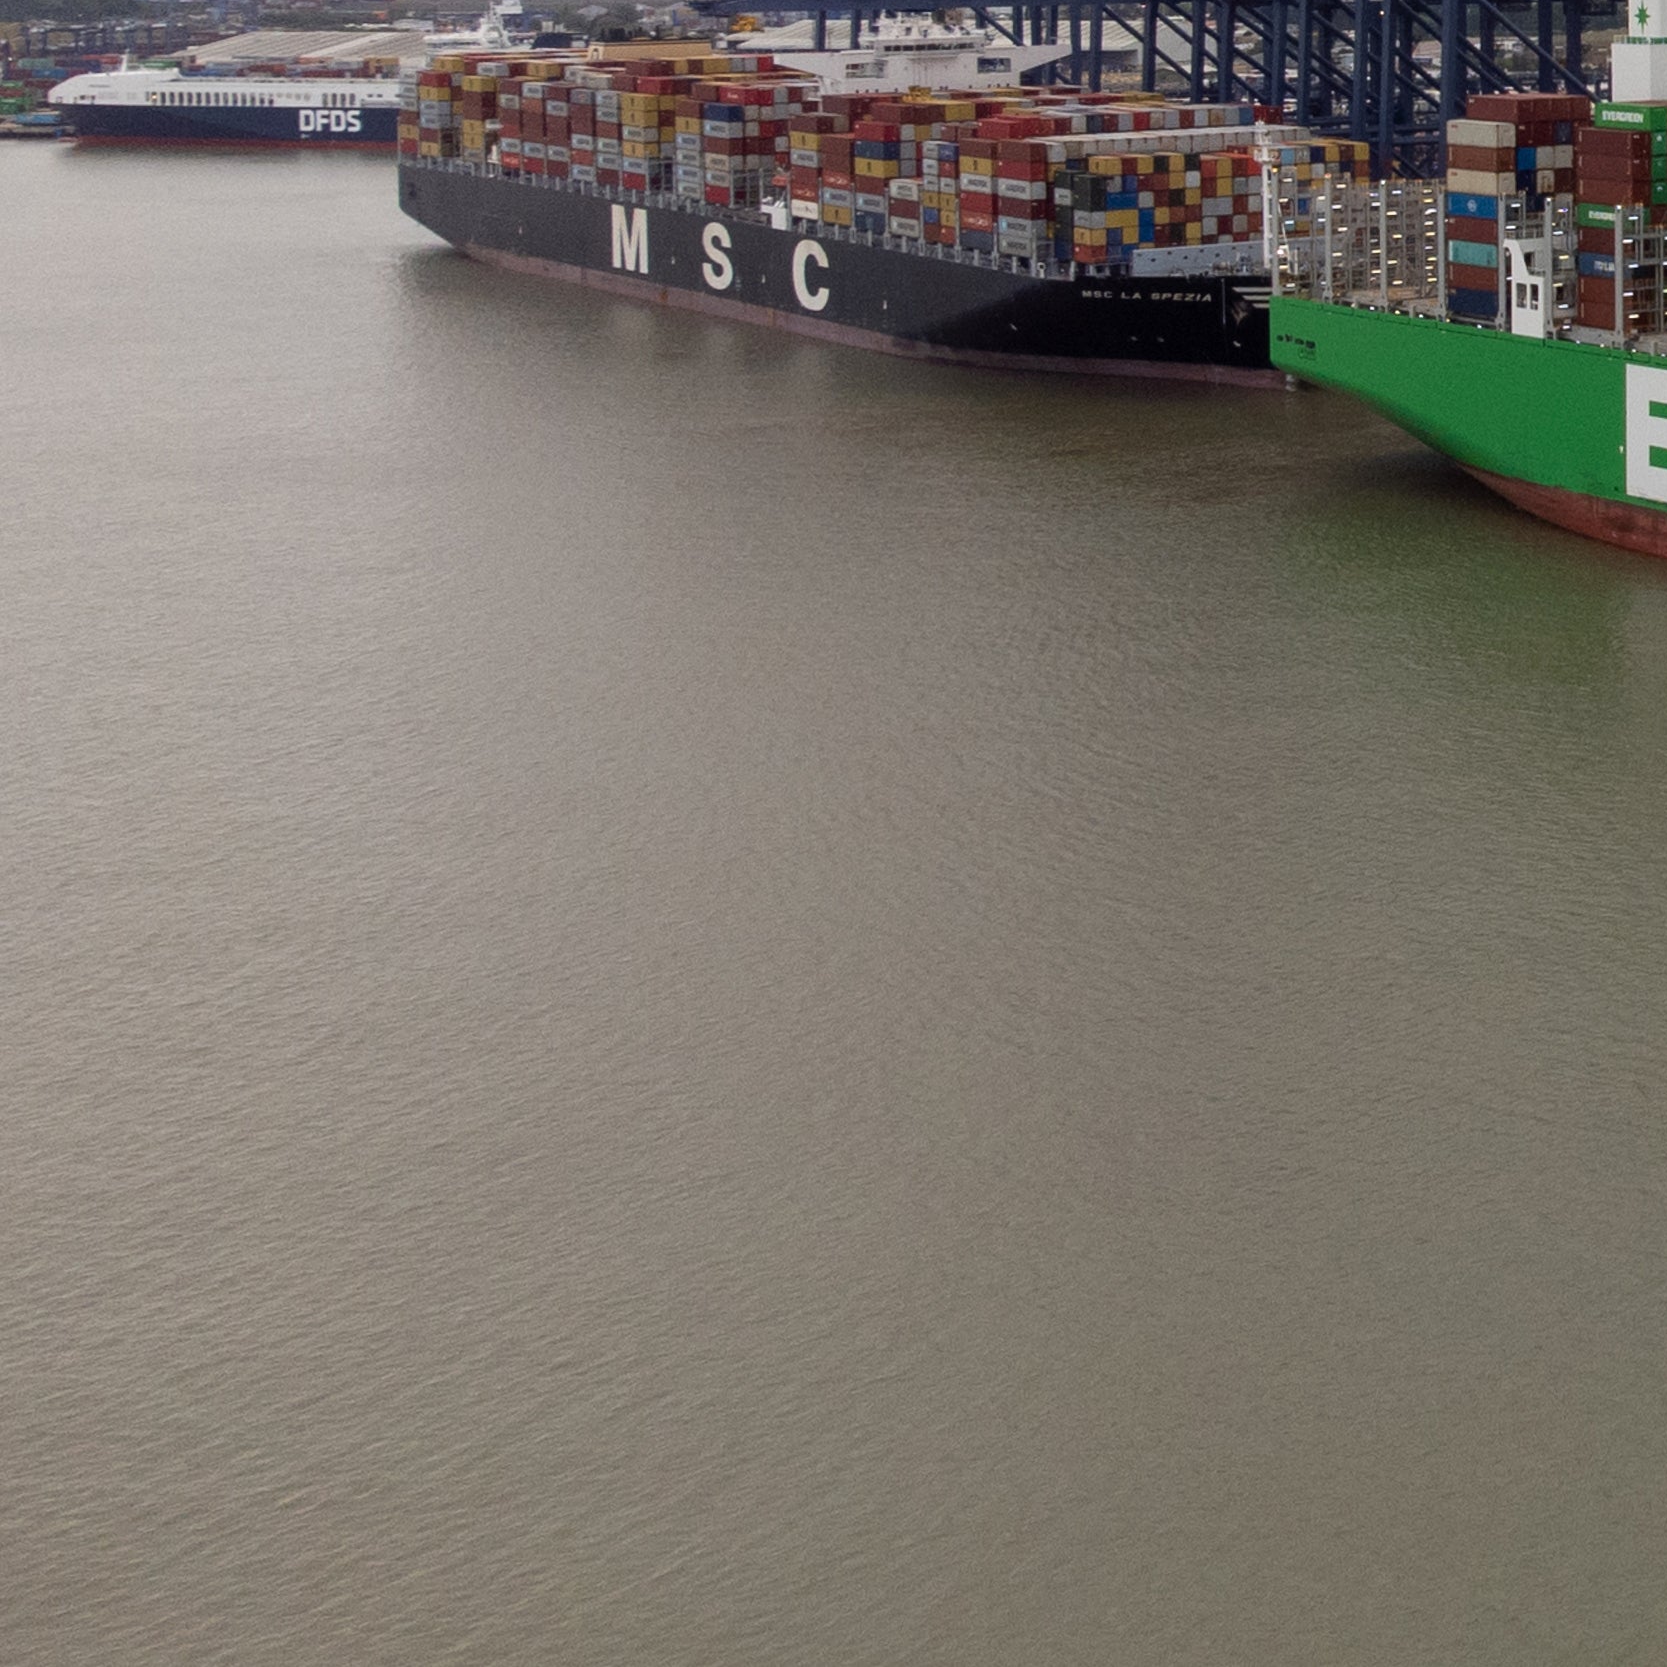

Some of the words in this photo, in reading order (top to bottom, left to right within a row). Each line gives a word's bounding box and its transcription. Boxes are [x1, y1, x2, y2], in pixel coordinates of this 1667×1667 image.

[299, 109, 361, 132] DFDS
[1081, 290, 1113, 299] MSC
[1121, 291, 1142, 300] LA
[1151, 292, 1212, 302] SPEZIA
